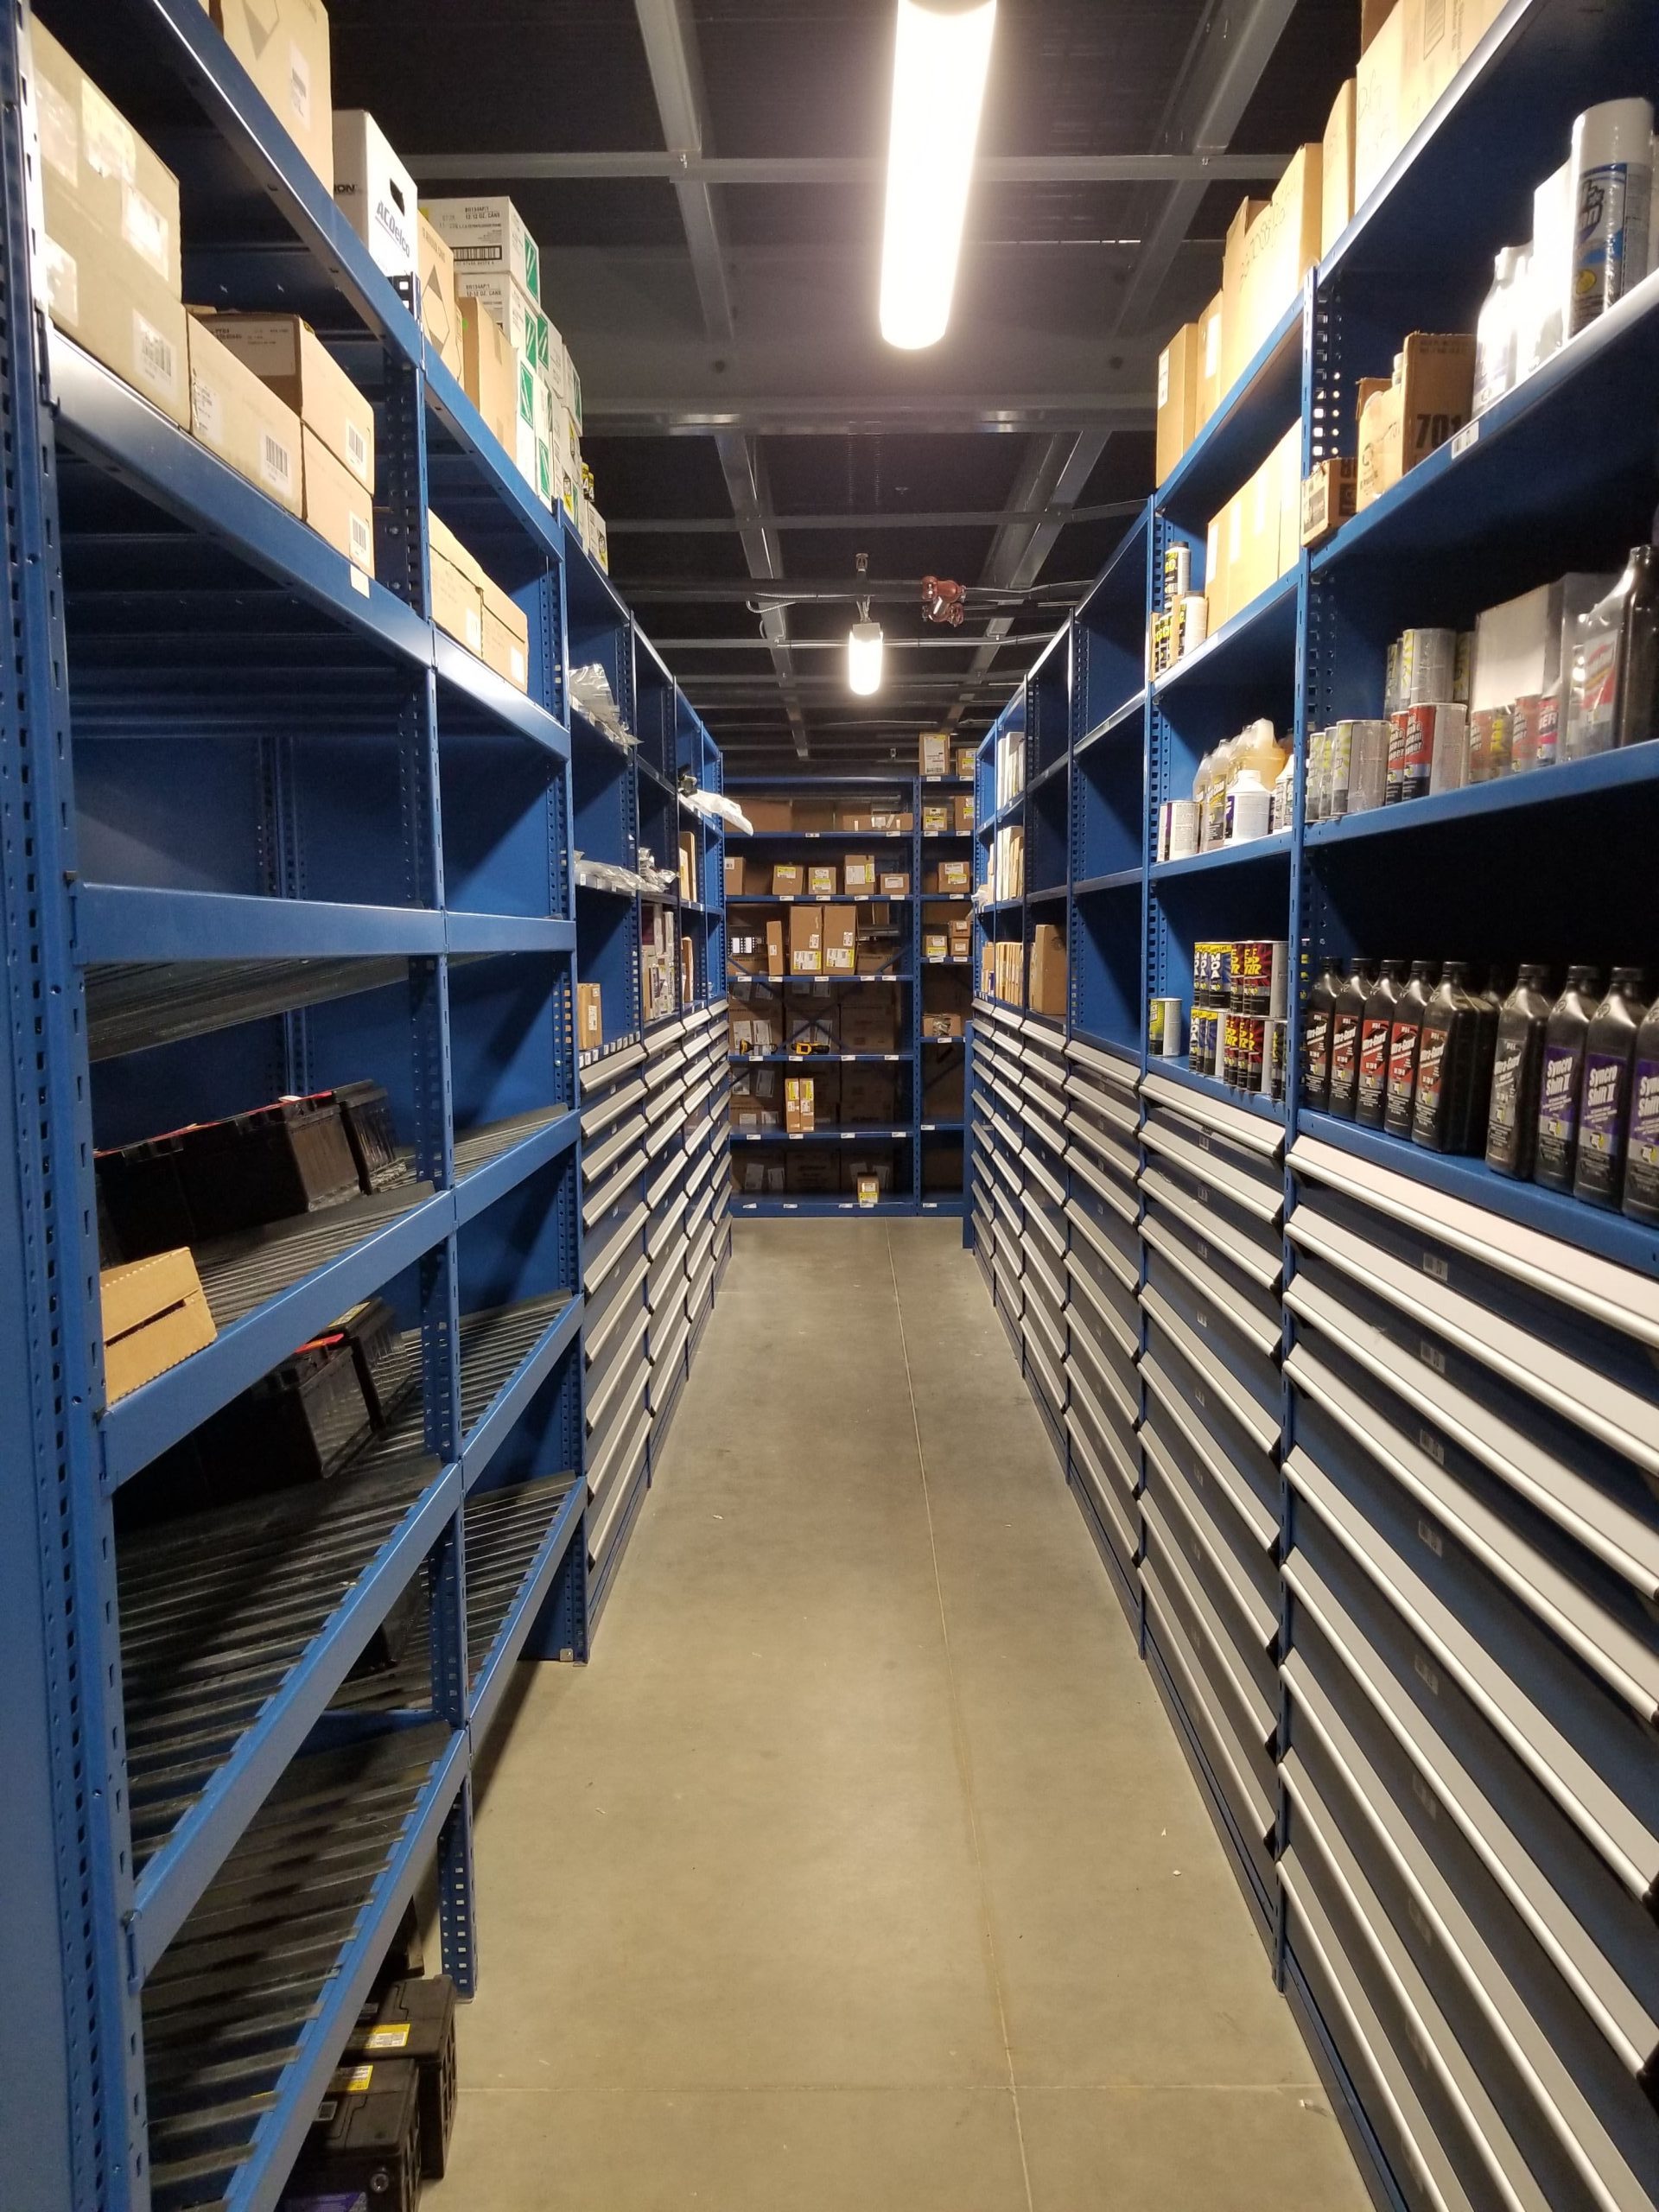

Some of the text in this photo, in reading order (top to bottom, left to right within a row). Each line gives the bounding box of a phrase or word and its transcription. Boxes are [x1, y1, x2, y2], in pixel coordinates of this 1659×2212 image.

[376, 200, 410, 257] ACDelco
[1211, 952, 1221, 979] MOA
[1547, 1057, 1573, 1078] Syncro
[1589, 1065, 1618, 1088] Syncro
